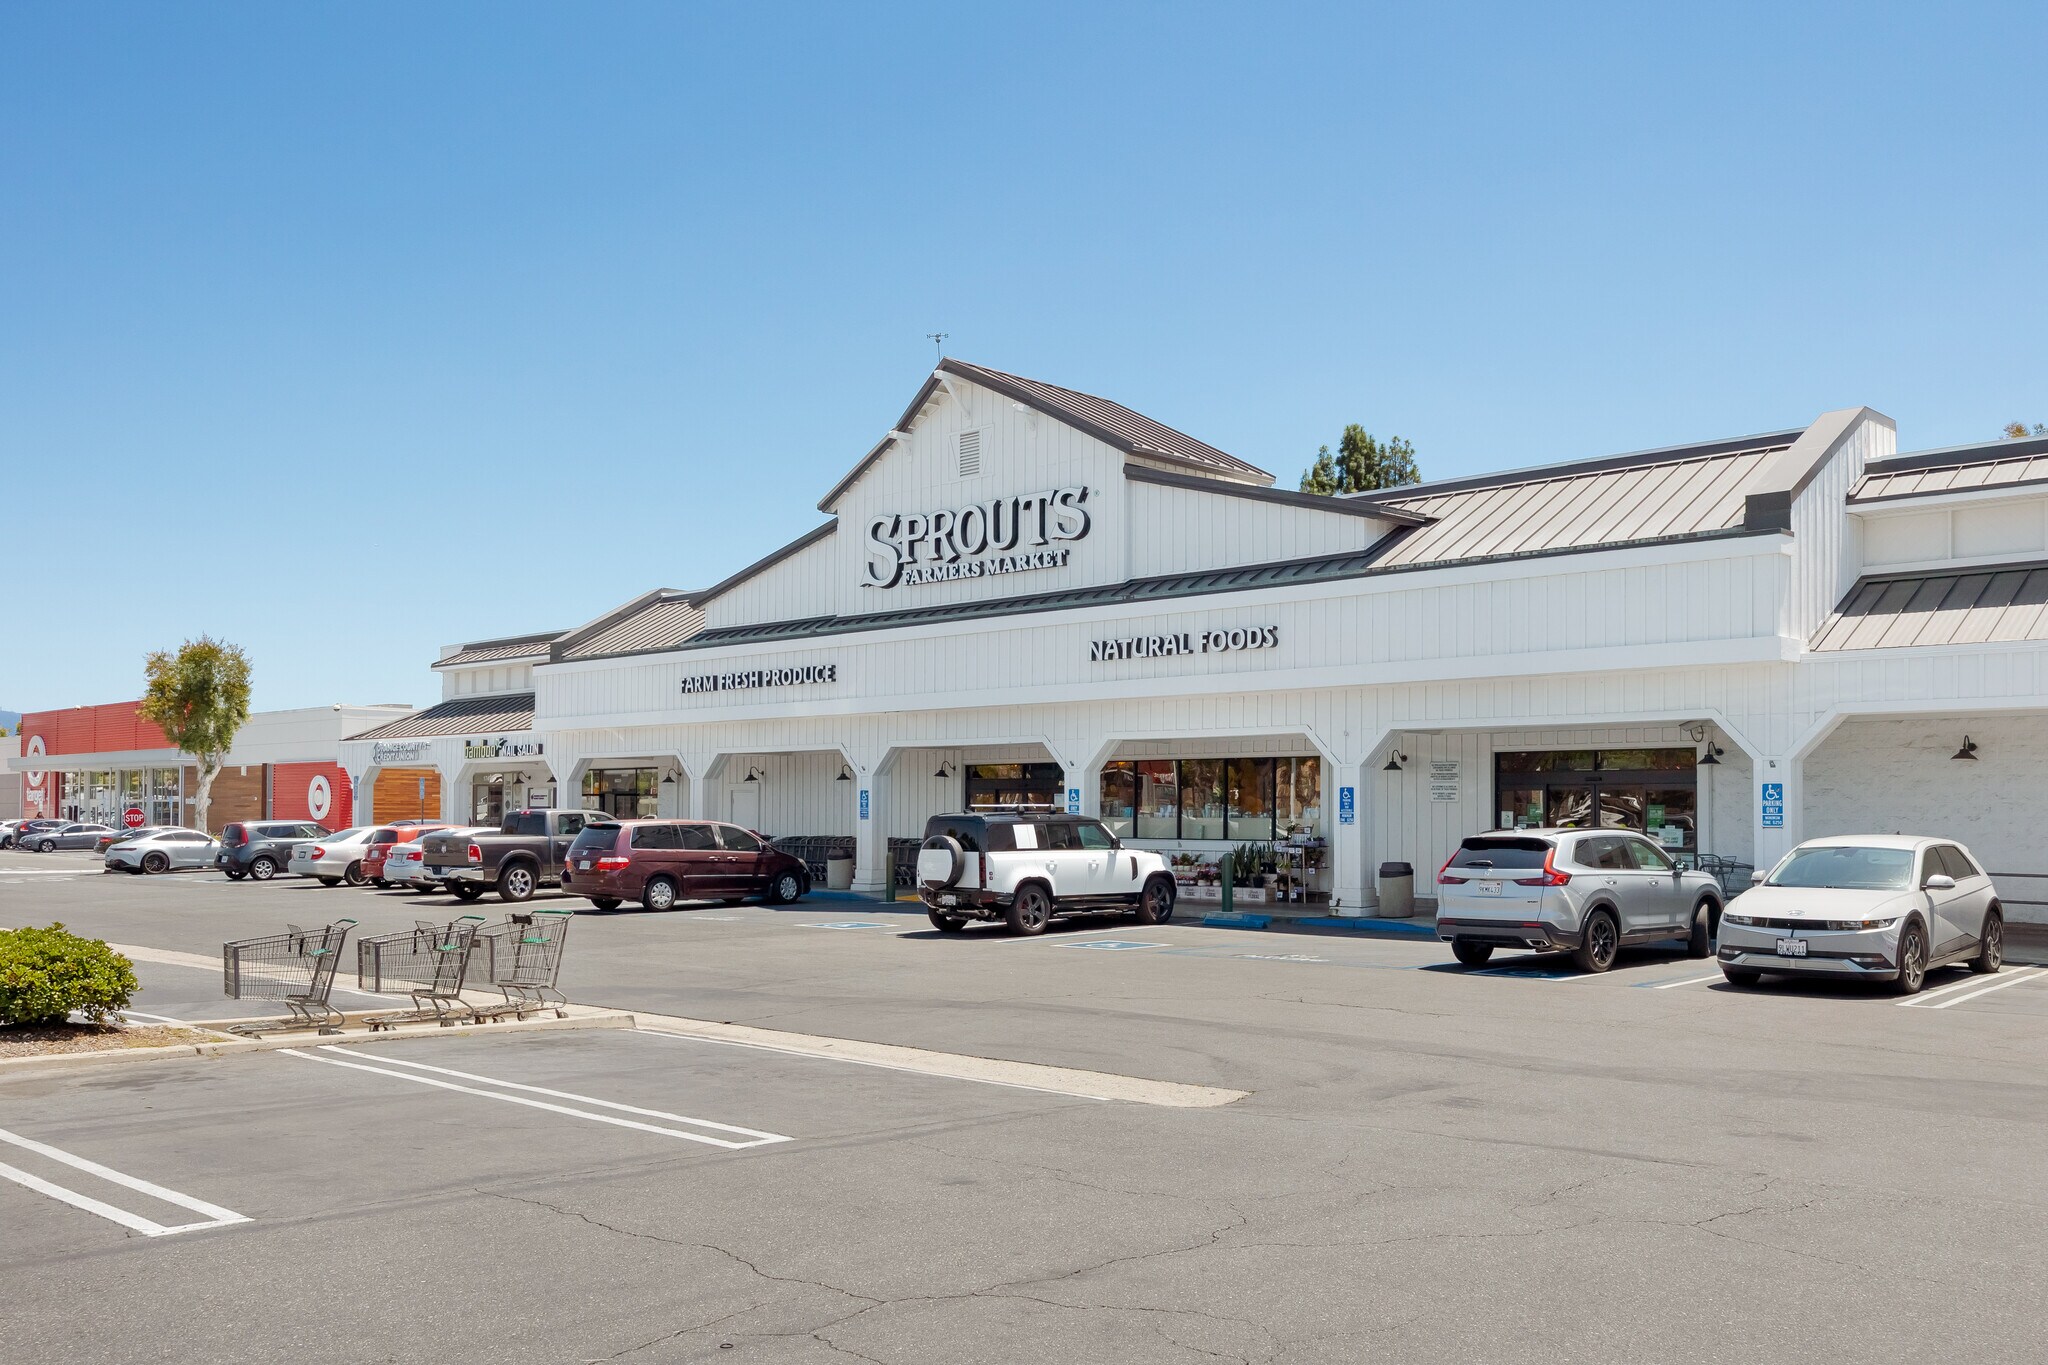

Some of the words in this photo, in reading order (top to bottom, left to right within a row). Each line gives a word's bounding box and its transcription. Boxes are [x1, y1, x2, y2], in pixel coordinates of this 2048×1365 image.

[860, 486, 1091, 588] SPROUTS
[901, 559, 984, 585] FARMERS
[985, 549, 1069, 575] MARKET
[1088, 633, 1193, 661] NATURAL
[1198, 625, 1279, 653] FOODS
[681, 676, 717, 694] FARM
[720, 671, 761, 690] FRESH
[763, 665, 836, 687] PRODUCE
[502, 745, 517, 757] NAIL
[517, 744, 541, 756] SALON
[125, 814, 144, 823] STOP
